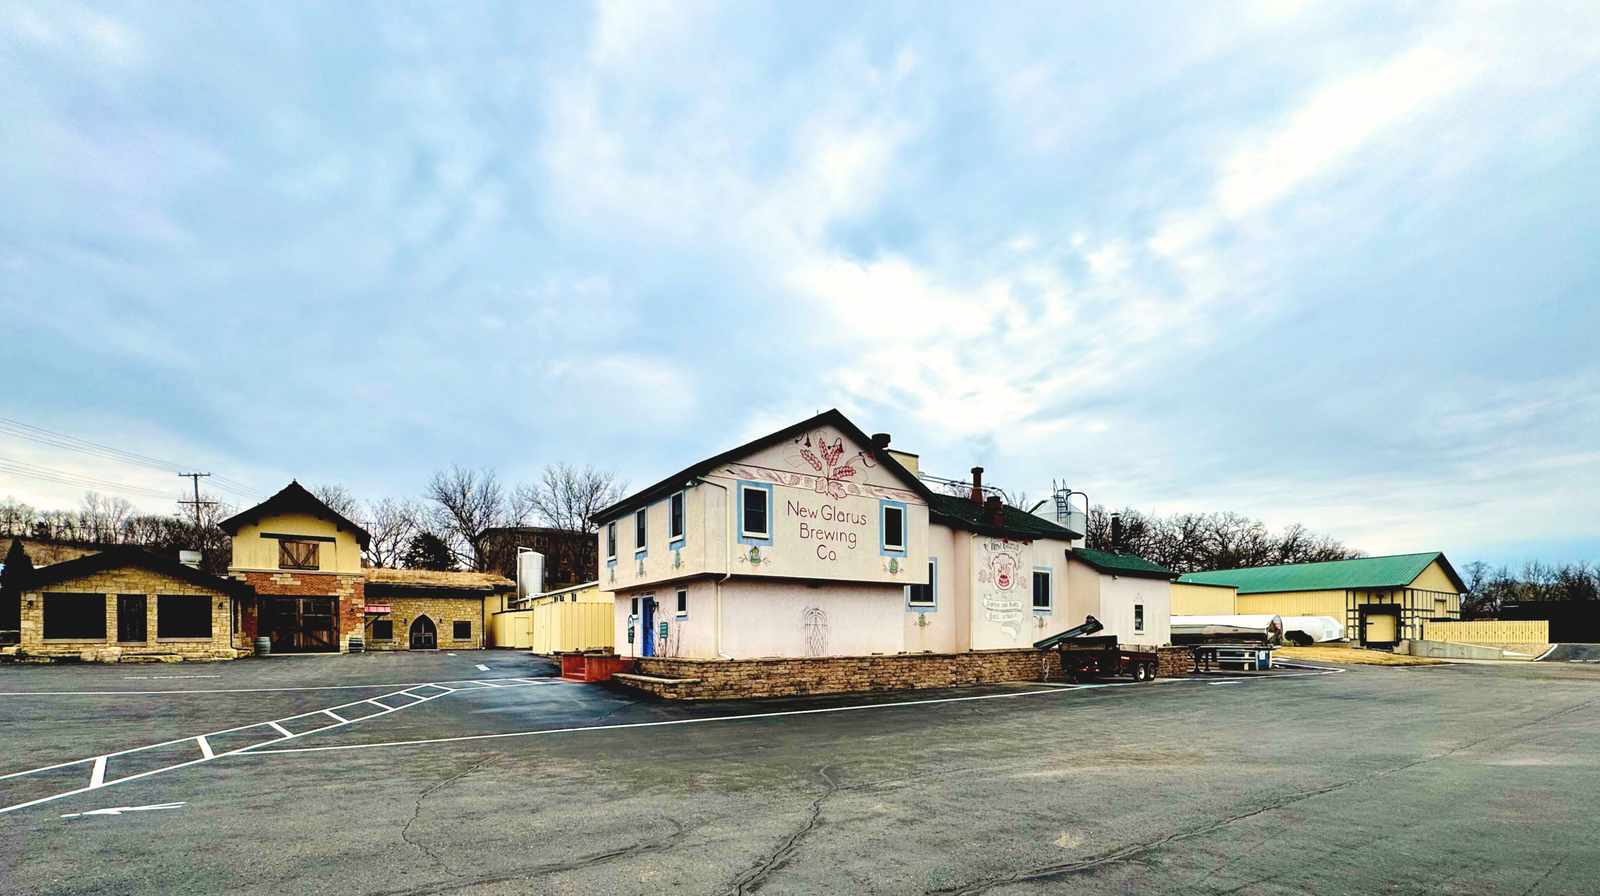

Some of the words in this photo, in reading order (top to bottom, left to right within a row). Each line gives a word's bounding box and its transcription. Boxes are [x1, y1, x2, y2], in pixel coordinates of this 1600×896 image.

[787, 499, 818, 519] New
[821, 504, 867, 526] Glarus
[799, 522, 857, 550] Brewing
